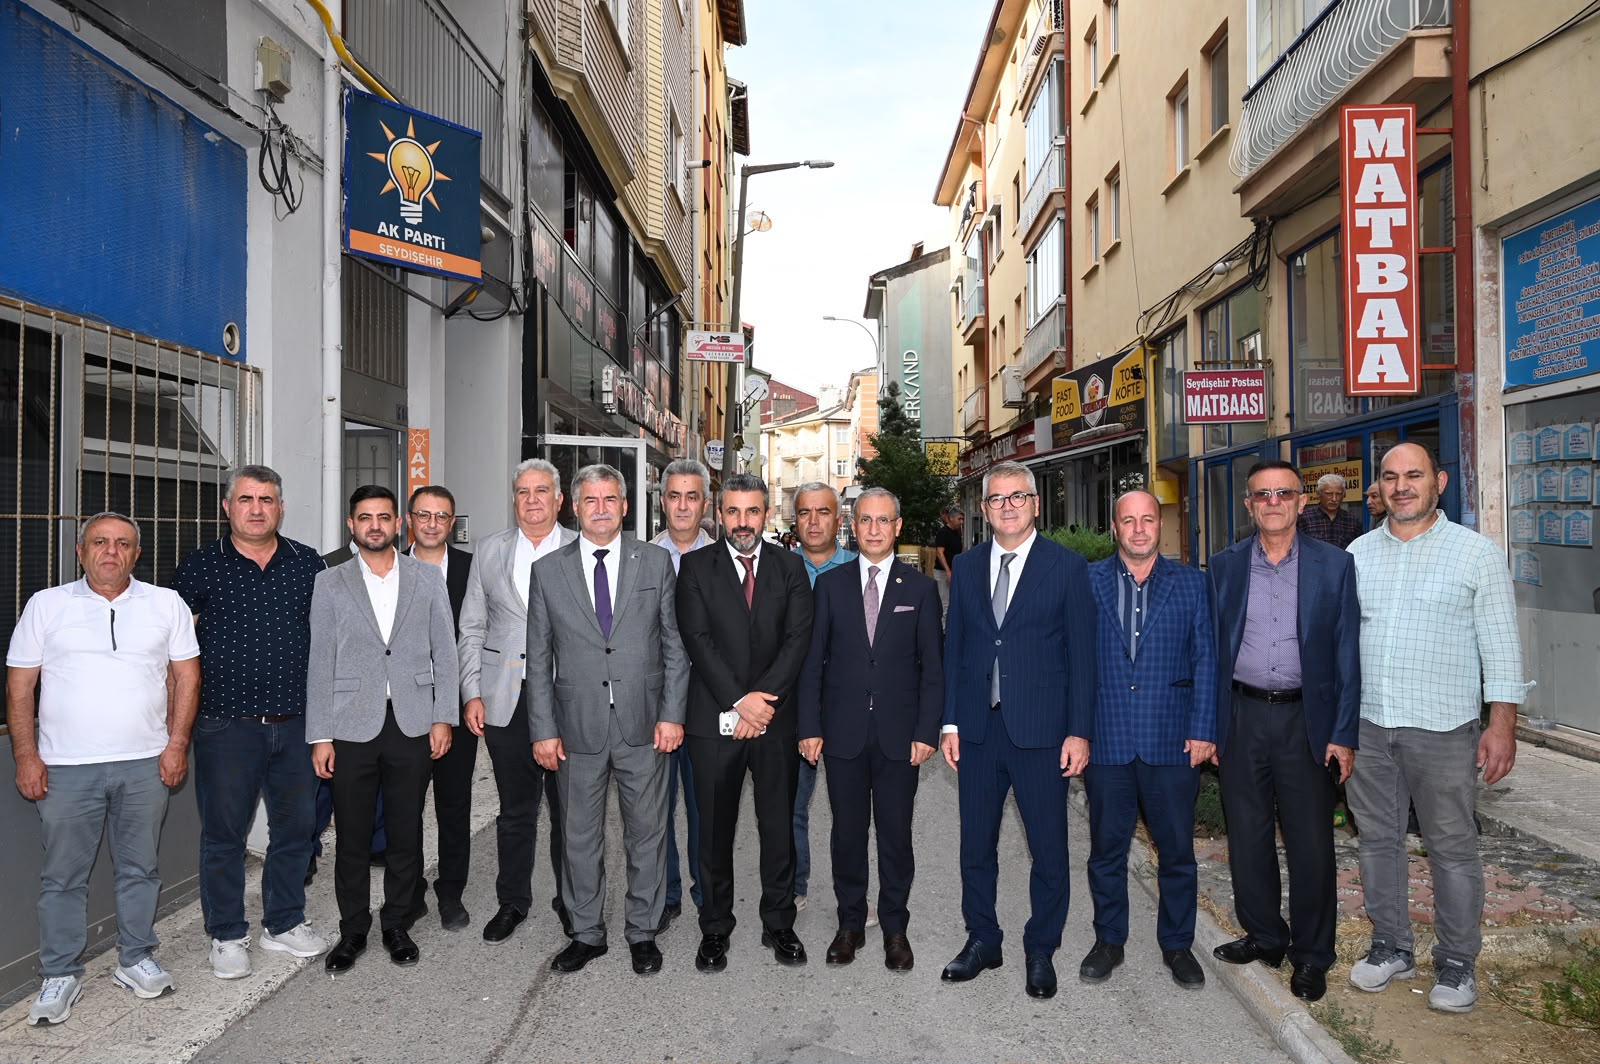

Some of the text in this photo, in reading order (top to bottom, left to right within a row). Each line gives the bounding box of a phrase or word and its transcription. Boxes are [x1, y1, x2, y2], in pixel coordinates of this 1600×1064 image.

[377, 221, 399, 238] AK
[1353, 118, 1409, 383] MATBAA
[903, 350, 921, 420] ERKAND
[1115, 381, 1141, 401] KÖFTE
[1186, 376, 1263, 390] Seydişehir Postası
[1056, 388, 1072, 404] FAST
[1187, 392, 1264, 417] MATBAASI
[1055, 402, 1074, 419] FOOD
[411, 452, 426, 479] AK
